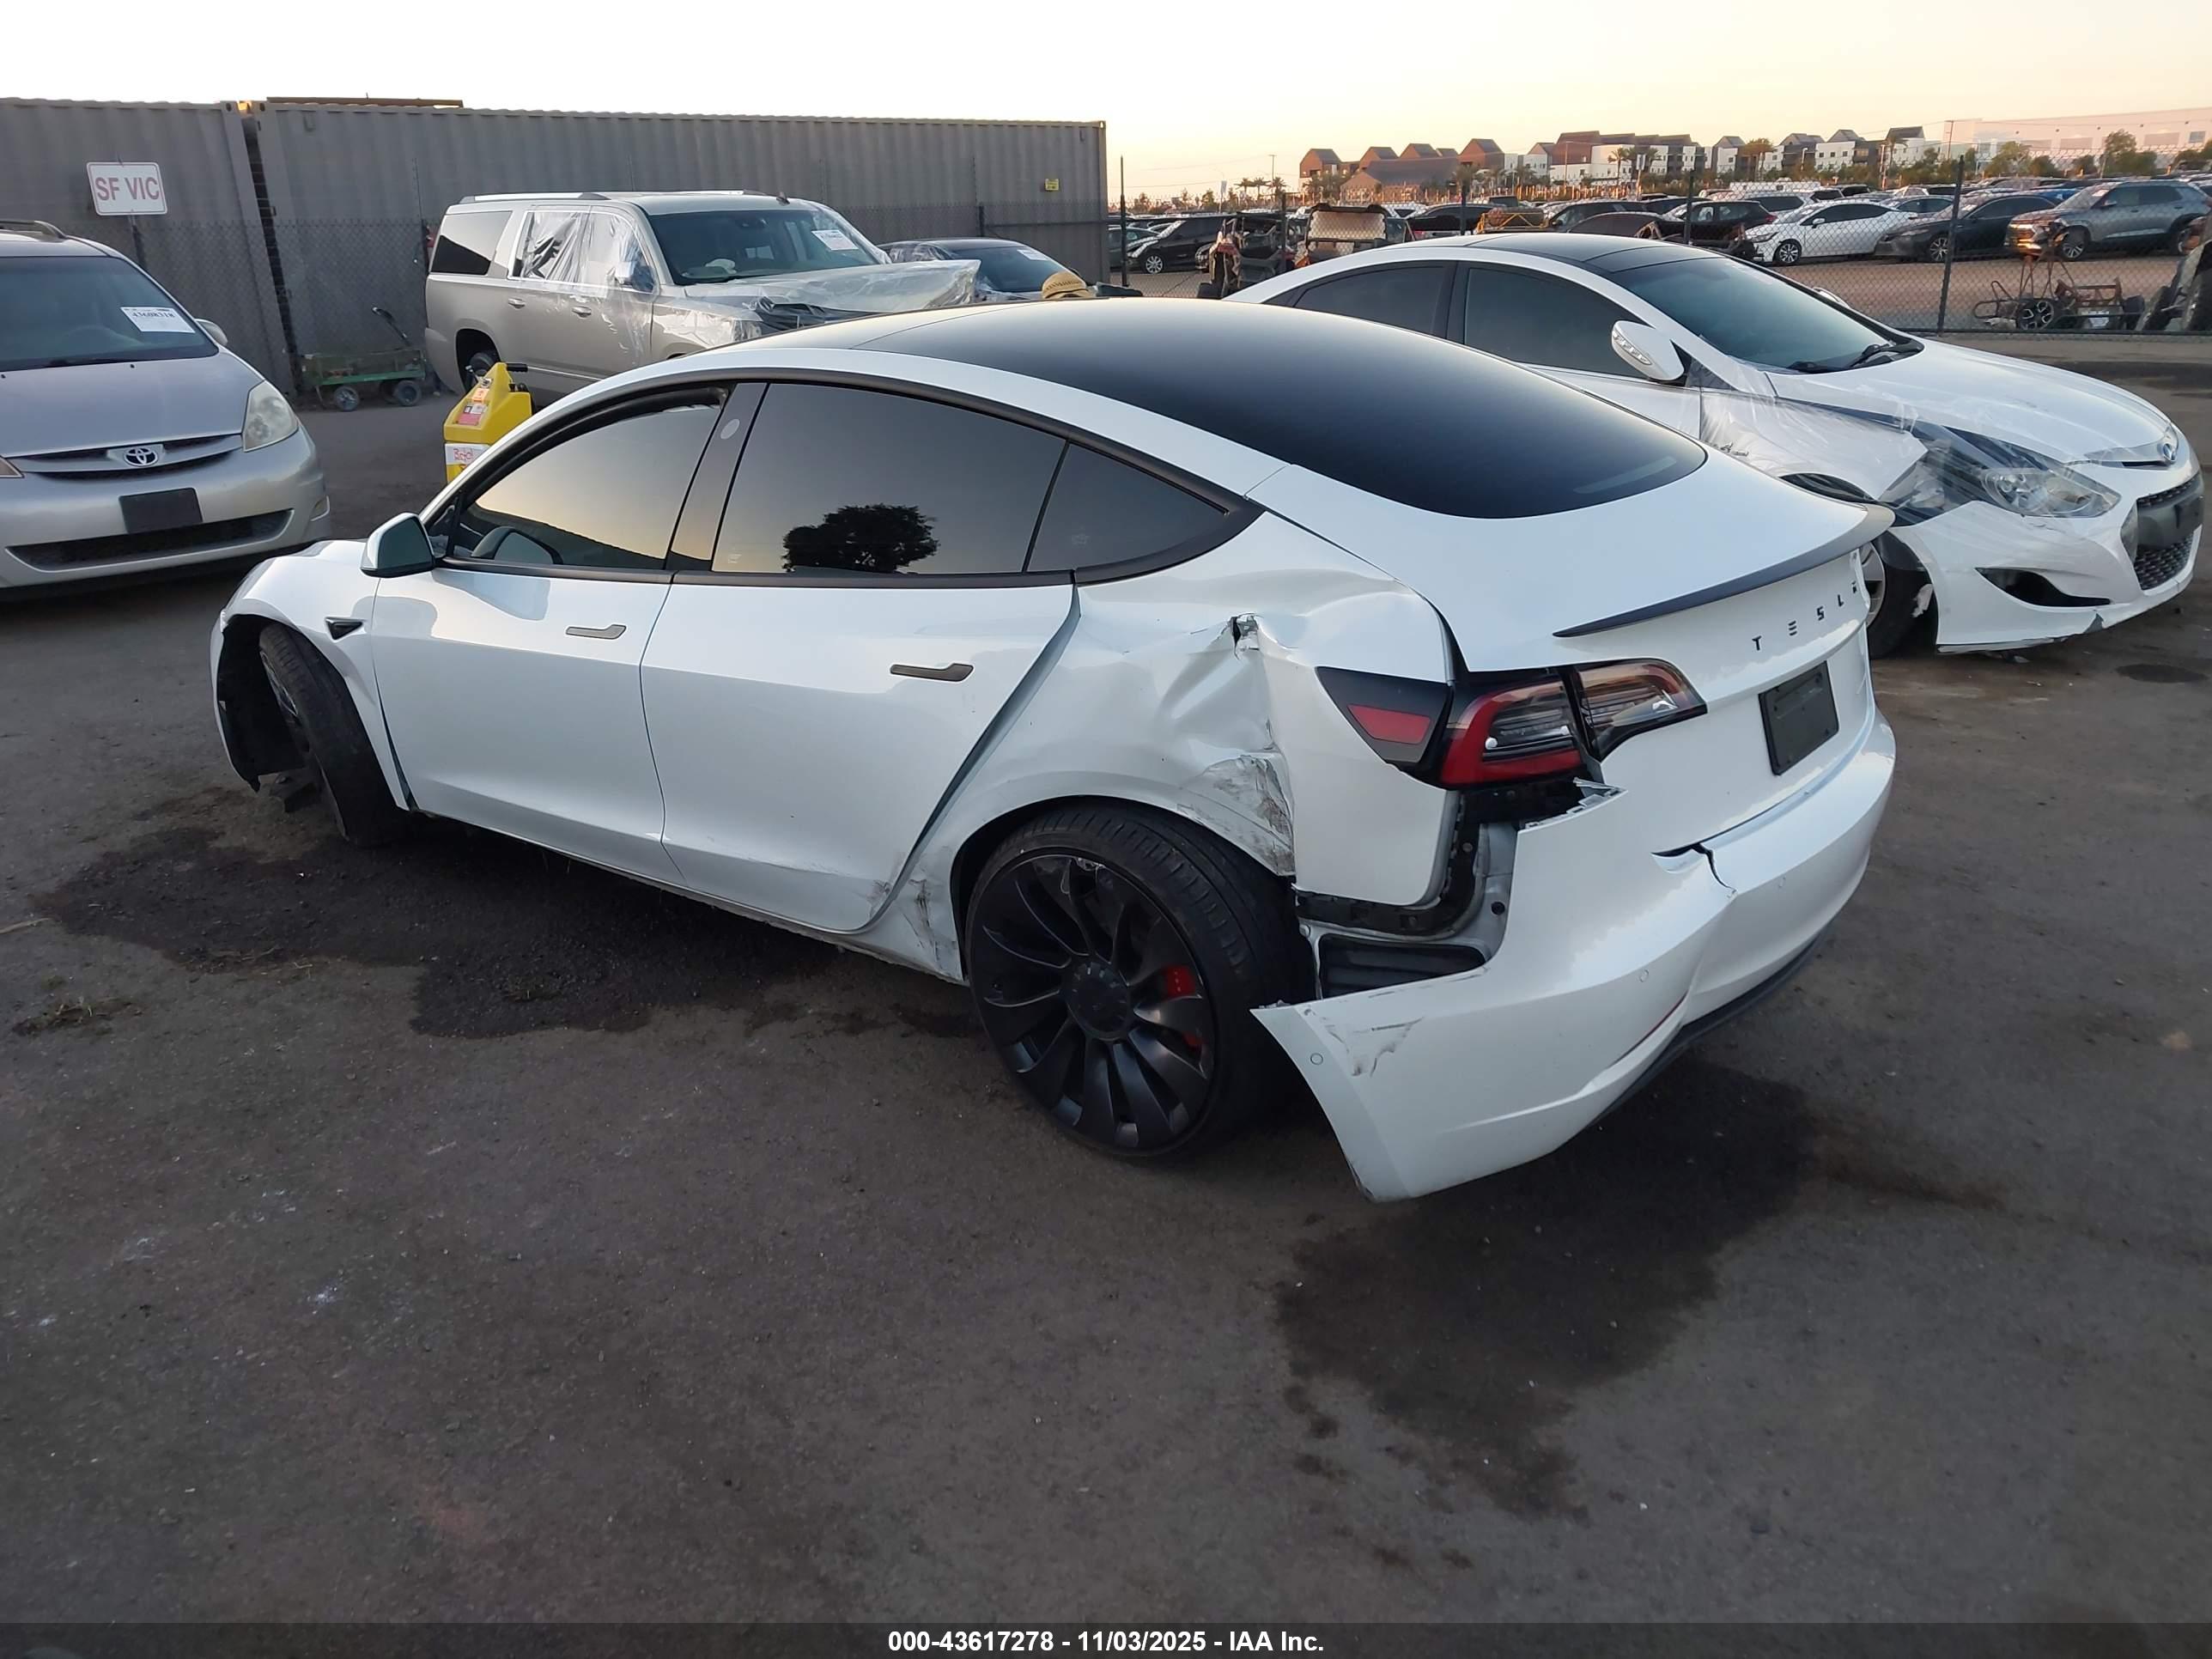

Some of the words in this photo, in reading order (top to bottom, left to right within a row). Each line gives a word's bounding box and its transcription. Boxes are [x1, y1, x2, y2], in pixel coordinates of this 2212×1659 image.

[94, 177, 119, 201] SF
[124, 177, 160, 200] VIC
[1752, 580, 1857, 651] TESLA
